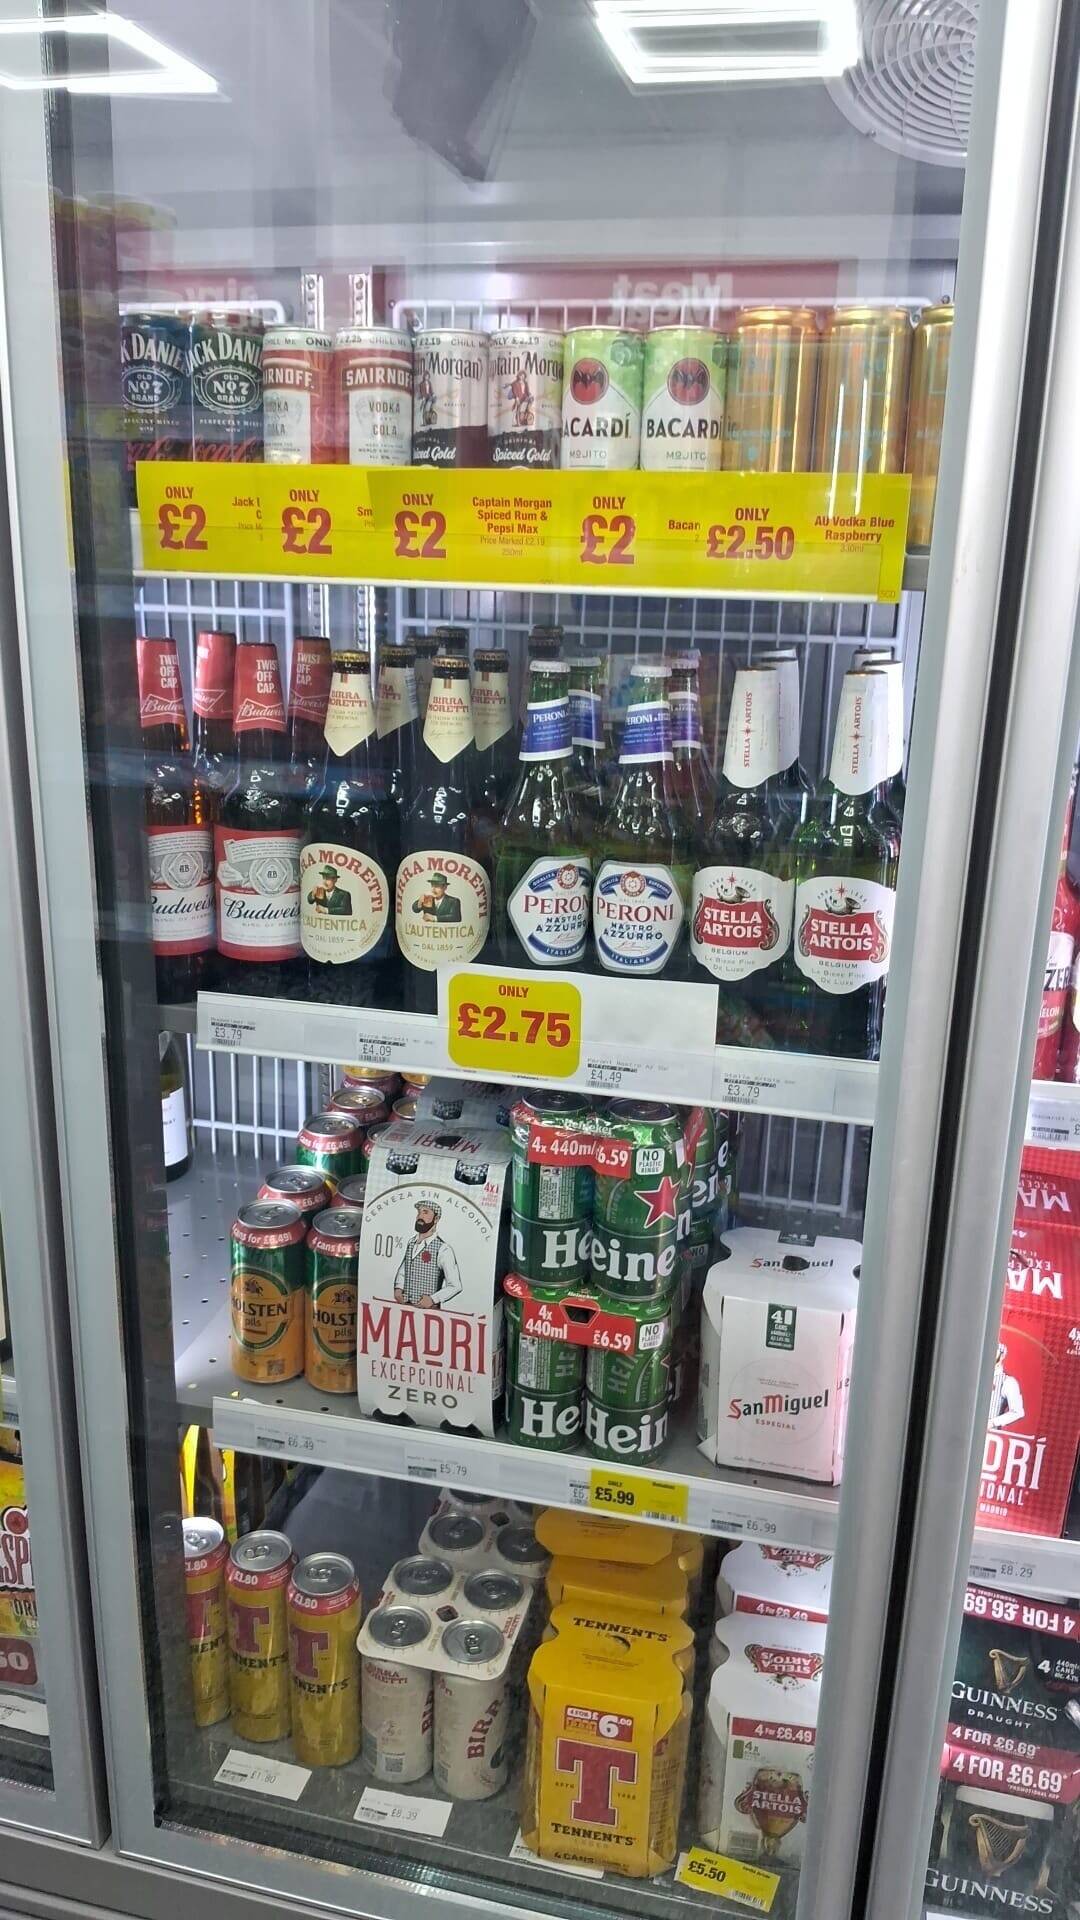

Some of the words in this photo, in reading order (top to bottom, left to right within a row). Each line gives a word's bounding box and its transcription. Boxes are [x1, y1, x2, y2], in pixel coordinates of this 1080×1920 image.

[306, 337, 332, 347] ONLY
[429, 352, 482, 380] Morgan
[217, 394, 246, 402] BRAND
[369, 401, 400, 413] VODKA
[373, 425, 397, 436] COLA
[431, 447, 456, 460] Gold
[493, 448, 524, 462] Spiced
[527, 448, 551, 462] Gold
[569, 450, 607, 459] MOJITO
[666, 451, 706, 460] MOJITO
[165, 486, 194, 499] ONLY
[289, 489, 320, 502] ONLY
[232, 497, 252, 507] Jack
[402, 494, 434, 506] ONLY
[472, 497, 510, 508] Captain
[513, 497, 552, 510] Morgan
[592, 496, 626, 510] ONLY
[477, 510, 512, 521] Spiced
[514, 510, 537, 521] Rum
[540, 511, 548, 521] &
[735, 508, 770, 521] ONLY
[158, 503, 208, 550] £2
[815, 516, 829, 526] AU
[832, 517, 865, 528] Vodka
[870, 517, 895, 528] Blue
[281, 506, 332, 555] £2
[394, 510, 447, 559] £2
[487, 523, 514, 535] Pepsi
[517, 523, 539, 534] Max
[480, 536, 500, 545] Price
[502, 536, 524, 545] Marked
[580, 514, 635, 565] £2
[706, 525, 796, 560] £2.50
[825, 530, 882, 543] Raspberry
[297, 653, 320, 664] TWIST
[160, 666, 175, 676] OFF
[296, 664, 311, 674] OFF
[161, 678, 178, 688] CAP.
[257, 671, 272, 682] OFF
[257, 683, 276, 694] CAP.
[332, 691, 360, 699] BIRRA
[472, 688, 500, 697] BIRRA
[433, 696, 463, 705] BIRRA
[428, 704, 469, 713] MORETTI
[533, 711, 566, 723] PERONI
[319, 850, 383, 913] MORETTI
[427, 857, 488, 918] MORETTI
[596, 896, 674, 923] PERONI
[704, 907, 762, 924] STELLA
[546, 914, 582, 924] NASTRO
[405, 923, 475, 939] L'AUTENTICA
[536, 921, 587, 932] AZZURRO
[611, 921, 653, 931] NASTRO
[702, 922, 762, 938] ARTOIS
[811, 919, 872, 936] STELLA
[603, 930, 663, 940] AZZURRO
[810, 936, 873, 951] ARTOIS
[546, 945, 580, 956] ITALIANA
[711, 948, 748, 956] BELGIUM
[611, 953, 650, 964] ITALIANA
[819, 961, 858, 969] BELGIUM
[498, 984, 529, 998] ONLY
[457, 1003, 571, 1047] £2.75
[215, 1027, 241, 1039] £3.79
[363, 1044, 391, 1056] £4.09
[591, 1069, 622, 1083] £4.49
[727, 1084, 760, 1097] £3.79
[532, 1136, 547, 1153] 4x
[643, 1151, 659, 1161] NO
[365, 1190, 413, 1223] CERVEZA
[421, 1190, 440, 1199] SIN
[447, 1196, 490, 1242] ALCOHOL
[248, 1232, 262, 1245] for
[317, 1240, 335, 1252] cans
[336, 1241, 351, 1253] for
[374, 1233, 403, 1258] 0.0%
[539, 1305, 552, 1321] 4x
[771, 1310, 783, 1324] 4
[245, 1315, 261, 1328] pils
[334, 1325, 352, 1338] pils
[526, 1318, 567, 1340] 440ml
[645, 1324, 660, 1336] NO
[360, 1302, 487, 1375] MADRÍ
[593, 1331, 631, 1351] £6.59
[371, 1360, 474, 1394] EXCEPCIONAL
[388, 1385, 457, 1409] ZERO
[727, 1389, 829, 1420] SanMiguel
[756, 1419, 797, 1430] ESPECIAL
[288, 1436, 314, 1450] £6.49
[440, 1463, 467, 1476] £5.79
[595, 1487, 635, 1506] £5.99
[746, 1520, 776, 1534] £6.99
[1000, 1564, 1033, 1578] £8.29
[233, 1571, 258, 1586] £1.80
[295, 1594, 318, 1609] £1.80
[964, 1593, 1019, 1621] £6.69
[756, 1603, 764, 1615] 4
[1022, 1606, 1058, 1631] FOR
[574, 1617, 668, 1642] TENNENT'S
[1064, 1619, 1075, 1635] 4
[761, 1660, 811, 1675] STELLA
[1038, 1660, 1050, 1673] 4
[951, 1681, 1058, 1721] GUINNESS
[968, 1708, 1032, 1729] DRAUGHT
[755, 1724, 764, 1736] 4
[777, 1727, 813, 1743] £6.49
[952, 1726, 962, 1738] 4
[964, 1728, 992, 1746] FOR
[953, 1753, 965, 1772] 4
[968, 1757, 1004, 1781] FOR
[251, 1769, 276, 1784] £1.80
[557, 1737, 638, 1828] T
[753, 1791, 800, 1804] STELLA
[751, 1801, 802, 1814] ARTOIS
[551, 1822, 635, 1846] TENNENT'S
[688, 1860, 726, 1882] £5.50
[925, 1868, 1053, 1914] GUINNESS
